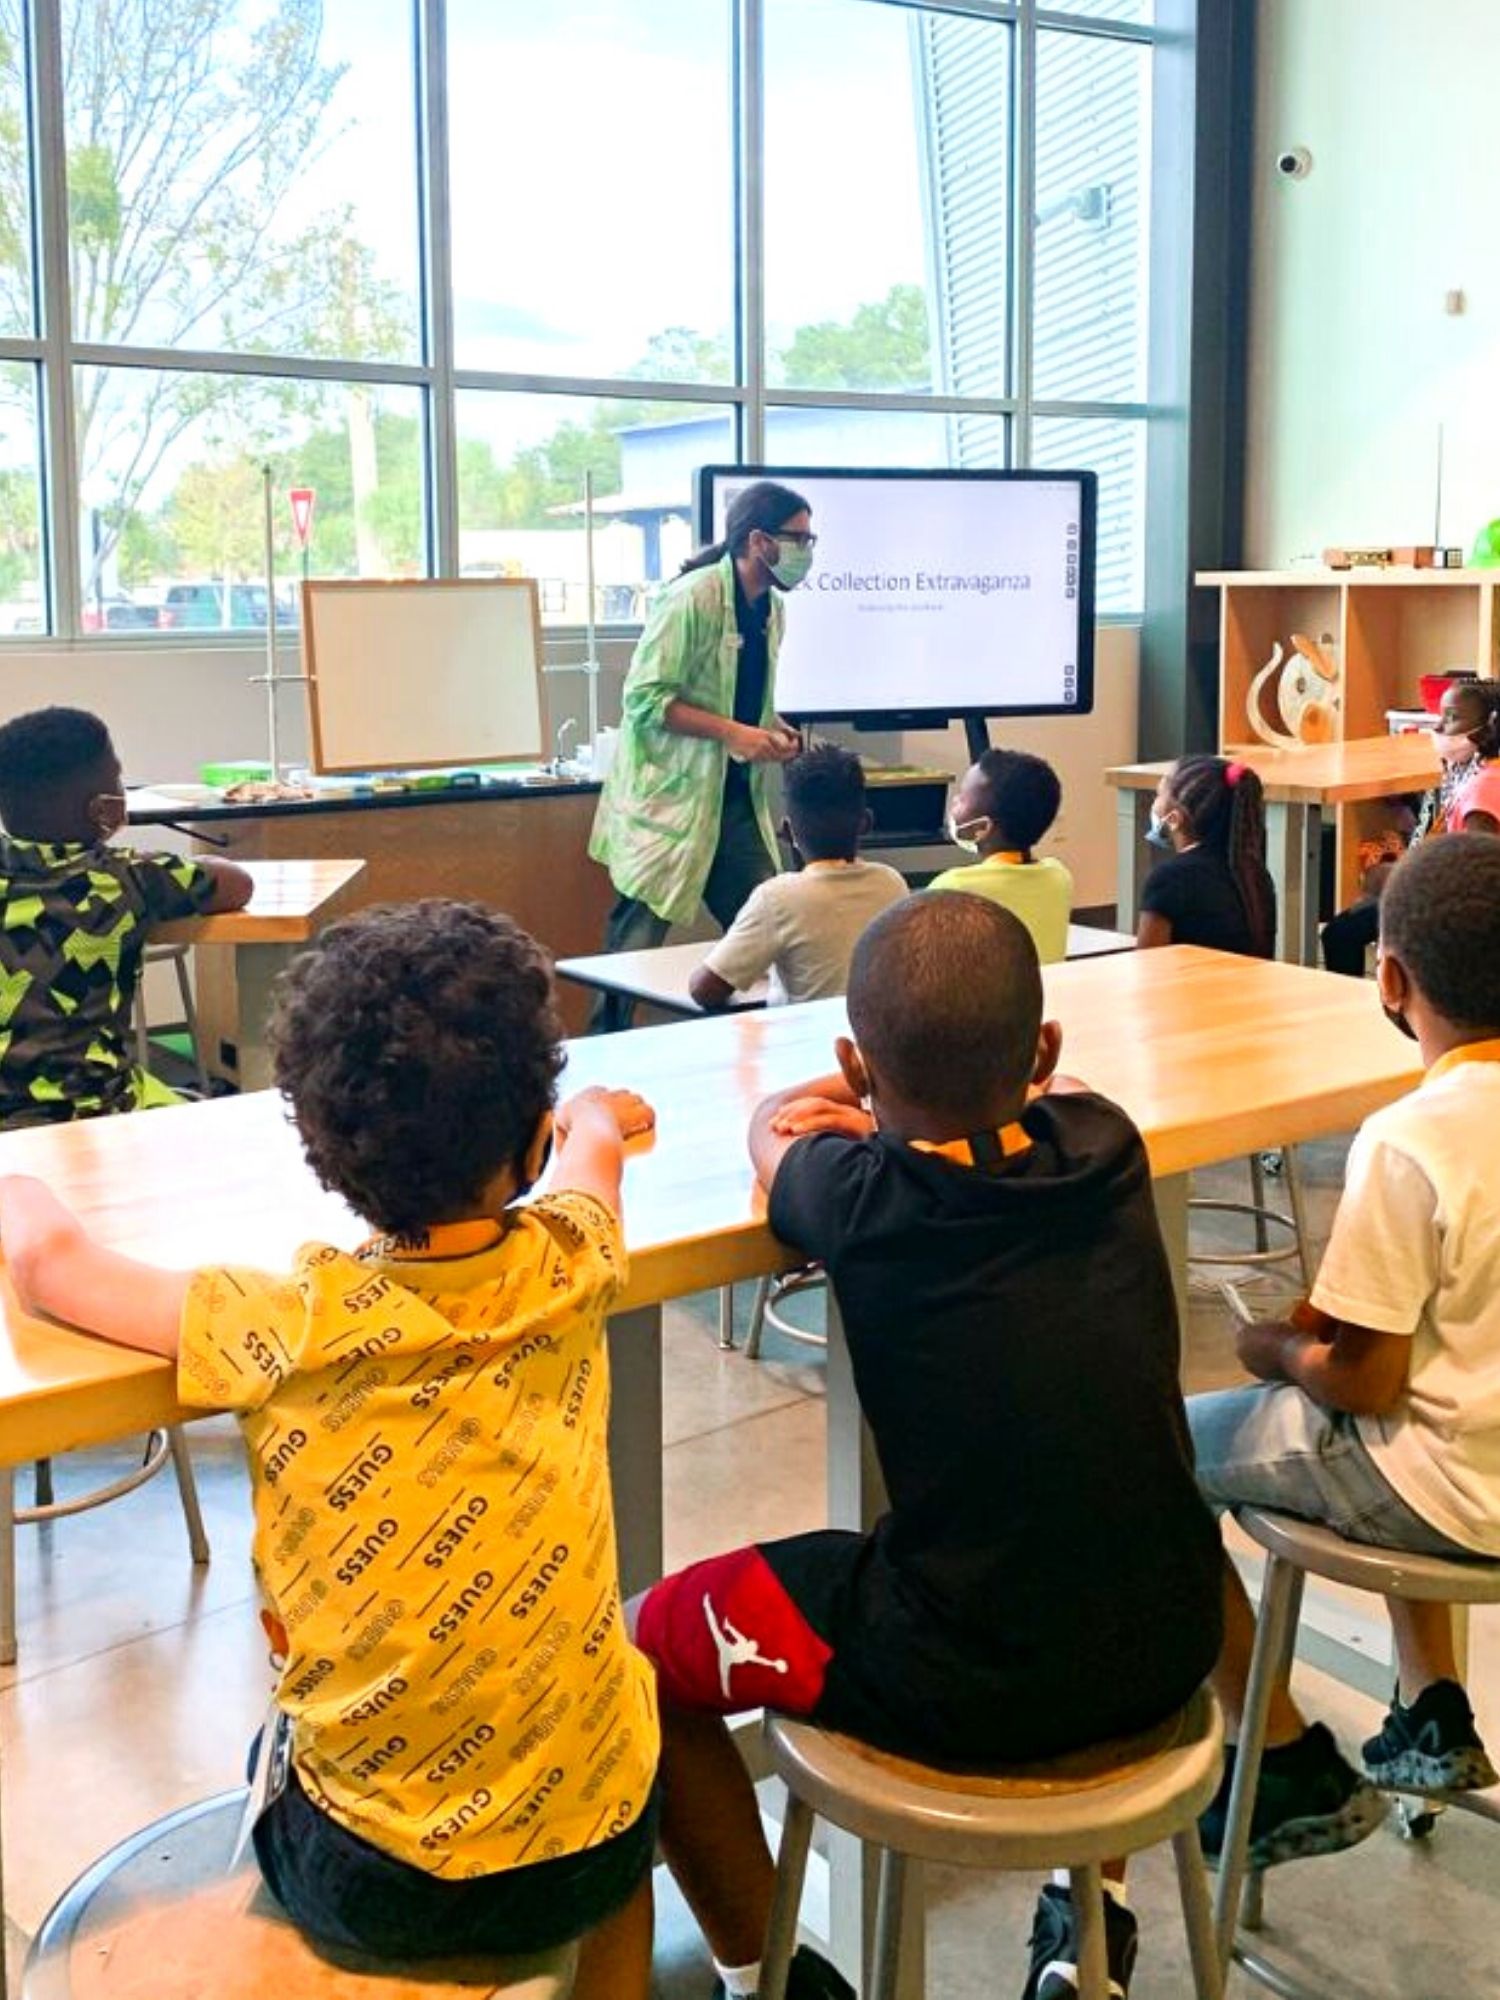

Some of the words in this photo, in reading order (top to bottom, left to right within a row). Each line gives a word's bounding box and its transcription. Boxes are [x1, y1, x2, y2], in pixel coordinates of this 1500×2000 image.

[818, 572, 910, 592] Collection
[916, 572, 1031, 596] Extravaganza
[343, 1276, 395, 1314] UESS
[242, 1330, 284, 1385] UESS
[563, 1358, 592, 1430] GUESS
[263, 1428, 307, 1488] GUES
[328, 1443, 394, 1513] GUESS
[336, 1518, 399, 1586] GUESS
[423, 1495, 489, 1570] GUESS
[429, 1569, 495, 1644] GUESS
[509, 1543, 570, 1620] GUESS
[583, 1582, 618, 1659] UESS
[340, 1676, 409, 1728] GUESS
[351, 1734, 408, 1782] GUES
[426, 1723, 496, 1784] GUESS
[419, 1787, 493, 1851] GUESS
